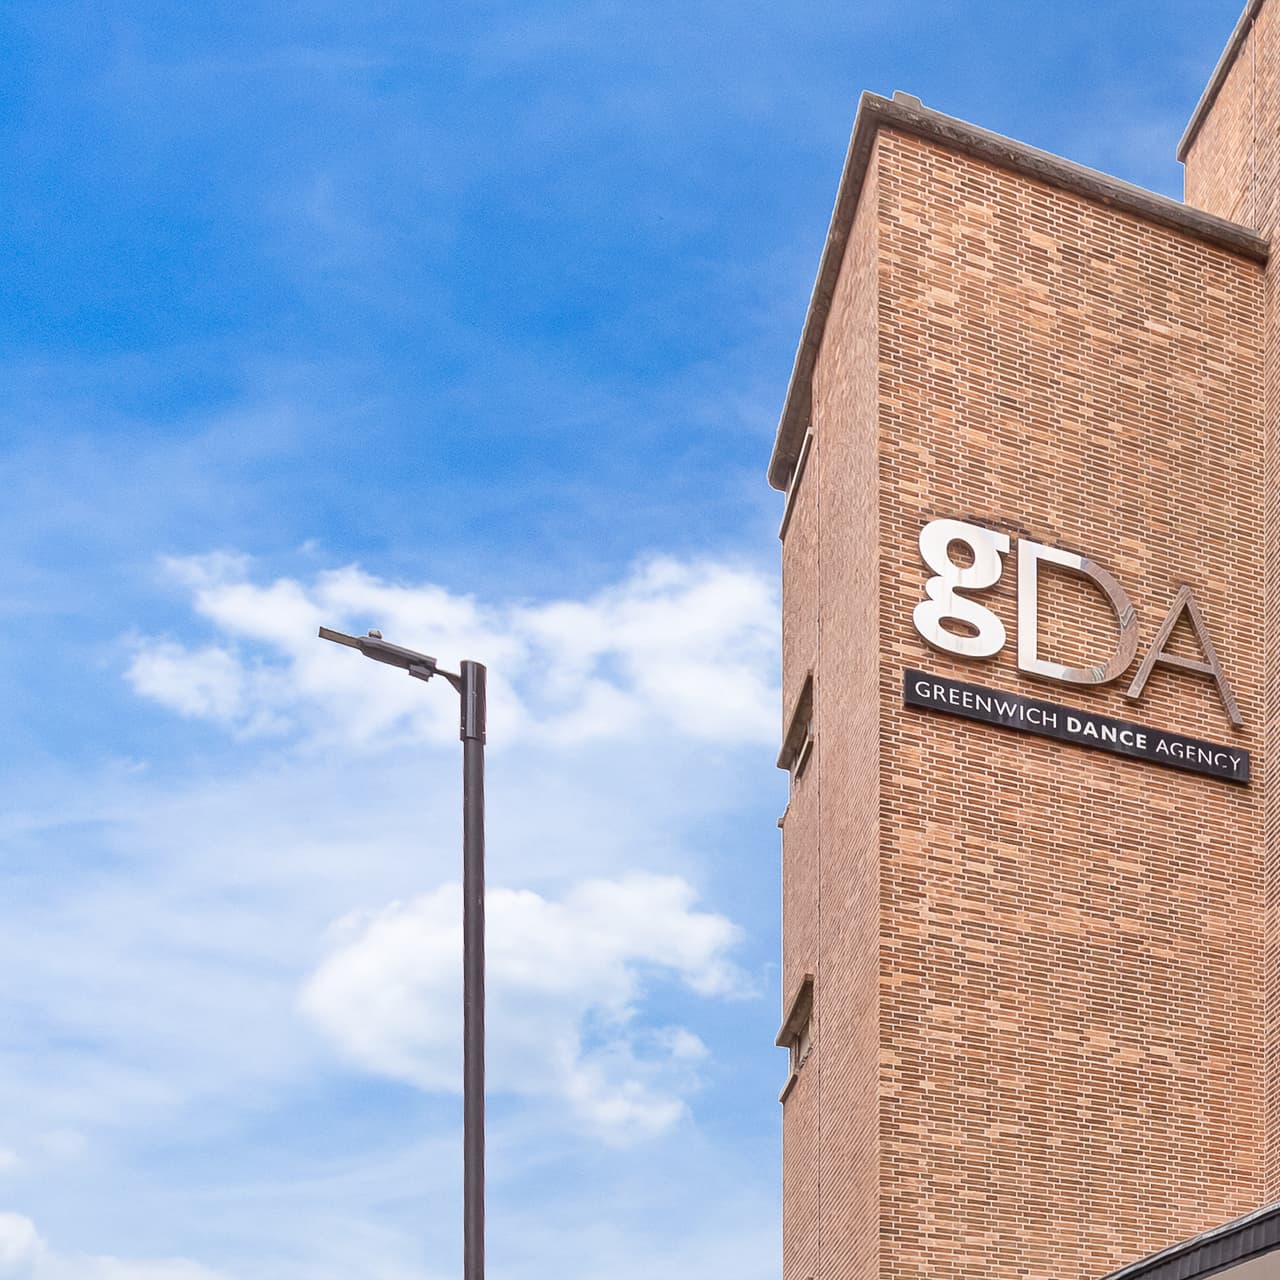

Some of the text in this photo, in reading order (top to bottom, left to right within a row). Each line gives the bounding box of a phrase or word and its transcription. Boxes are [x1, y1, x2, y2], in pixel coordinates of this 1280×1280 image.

[915, 680, 1242, 772] GREENWICH DANCE AGENCY
